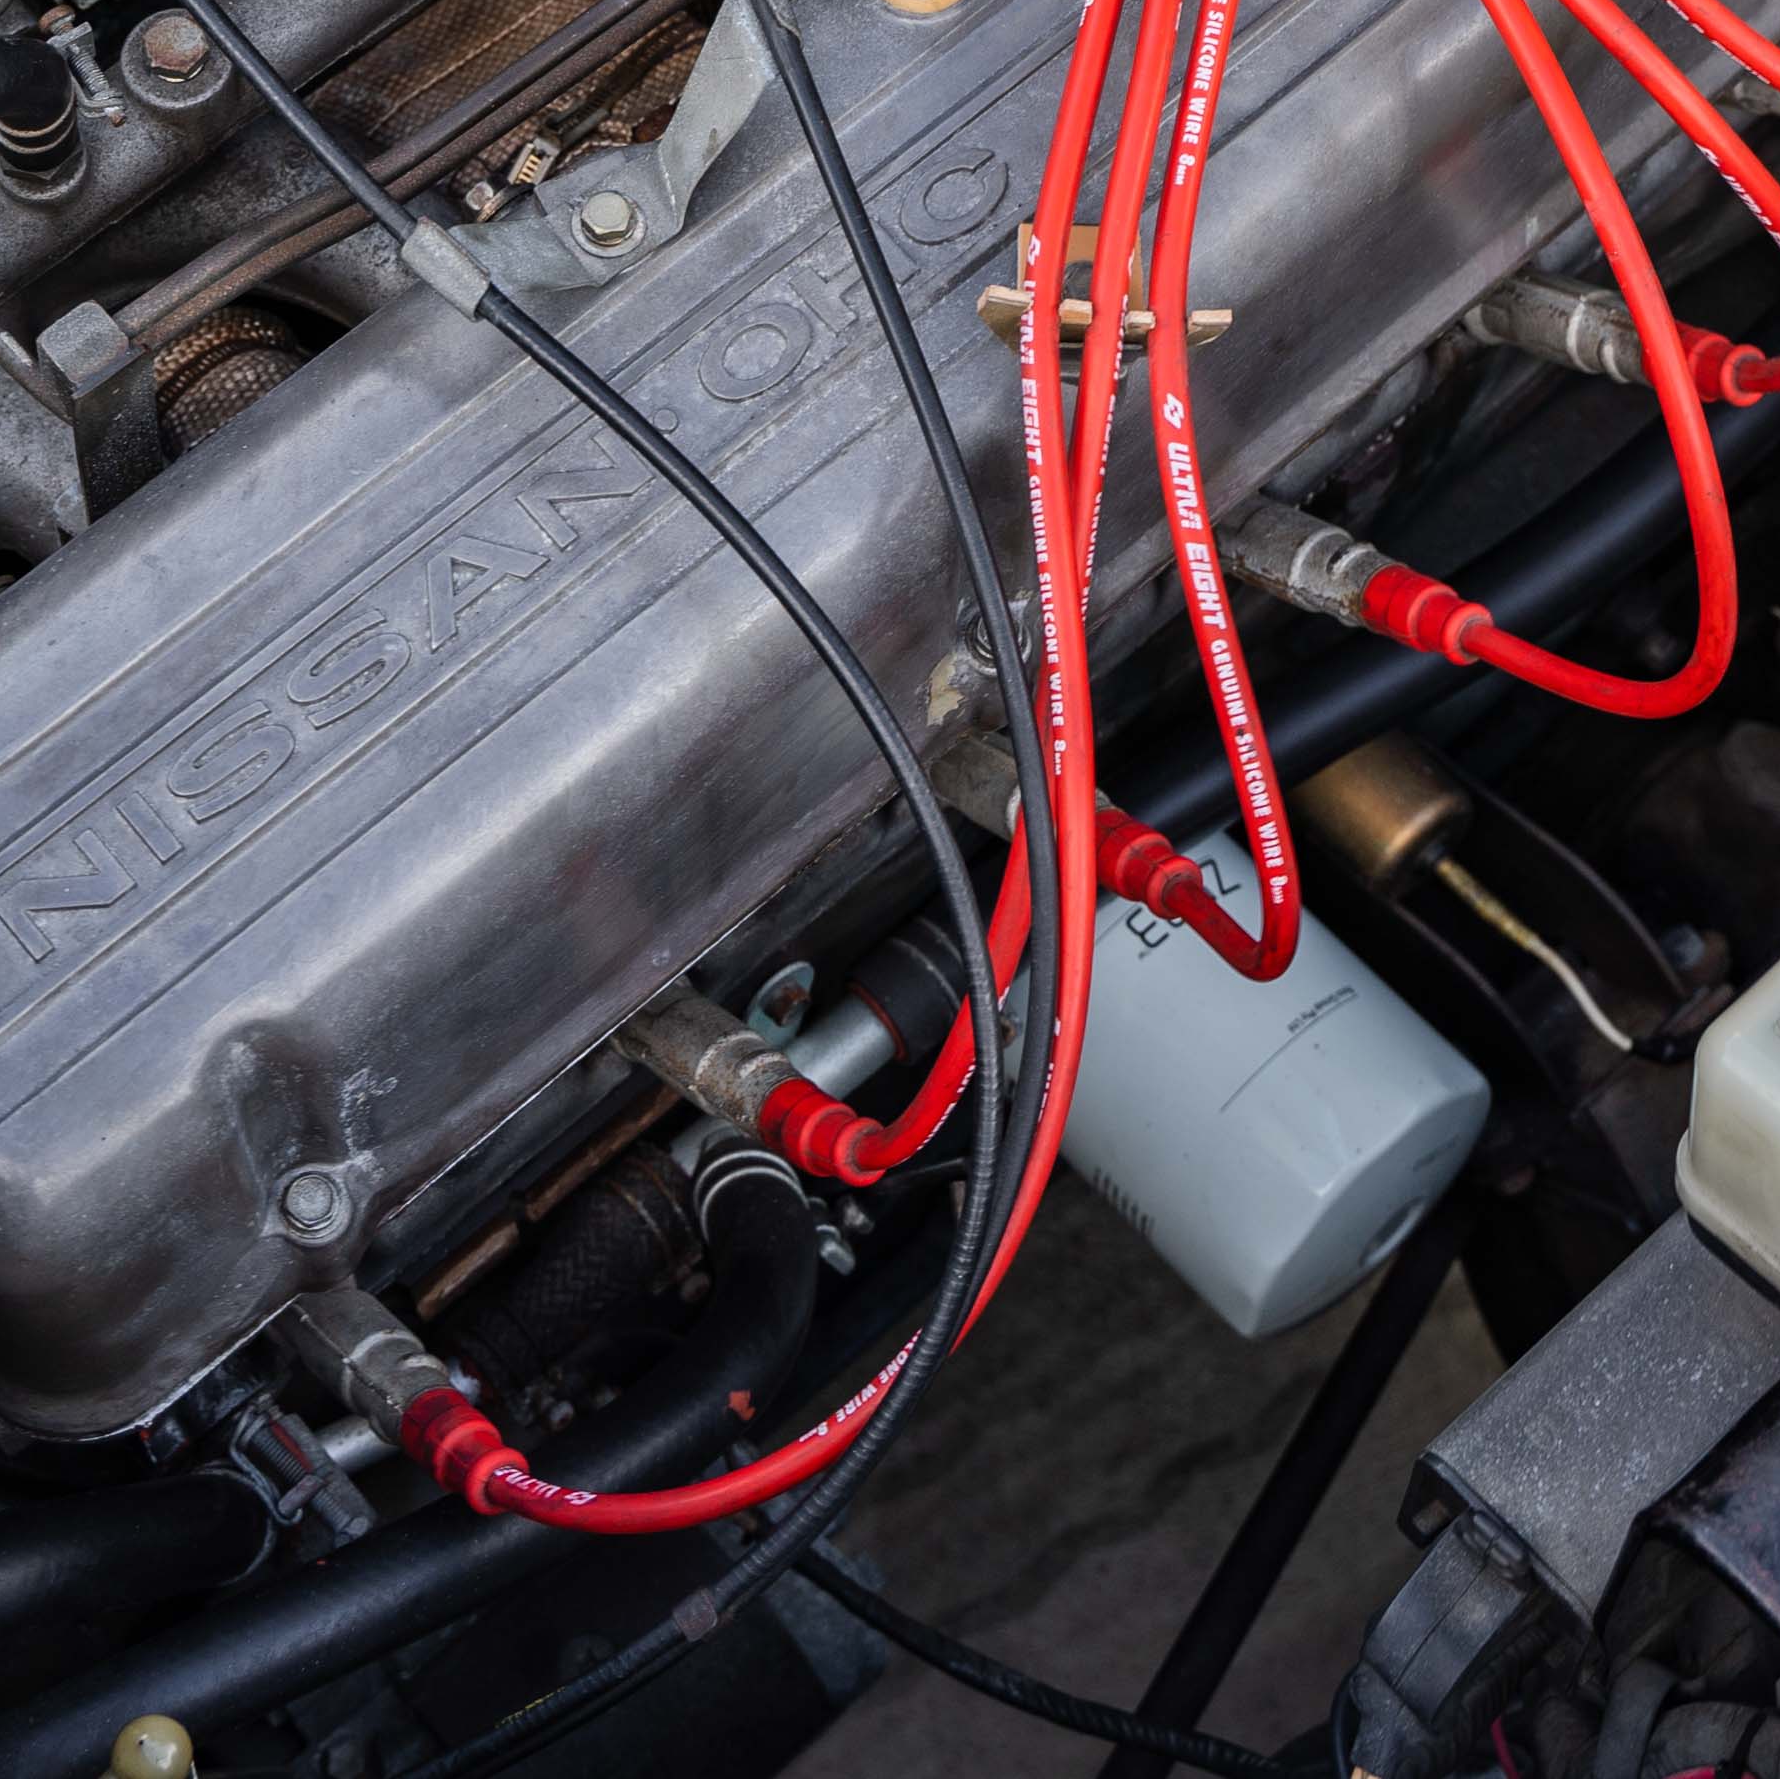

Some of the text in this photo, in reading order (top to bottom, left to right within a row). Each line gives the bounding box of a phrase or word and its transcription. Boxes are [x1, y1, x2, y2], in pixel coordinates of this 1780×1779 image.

[1193, 8, 1228, 94] SILICONE
[1180, 97, 1207, 145] WIRE
[697, 147, 1012, 402] OHC
[1020, 376, 1043, 467] EIGHT
[1027, 473, 1050, 565] GENUINE
[1167, 442, 1204, 532] ULTRA
[1037, 570, 1059, 666] SILICONE
[1184, 539, 1227, 633] EIGHT
[1047, 670, 1066, 728] WIRE
[1210, 637, 1248, 727] GENUINE
[1233, 732, 1272, 819] SILICONE
[1255, 819, 1286, 871] WIRE
[834, 1383, 877, 1425] WIRE
